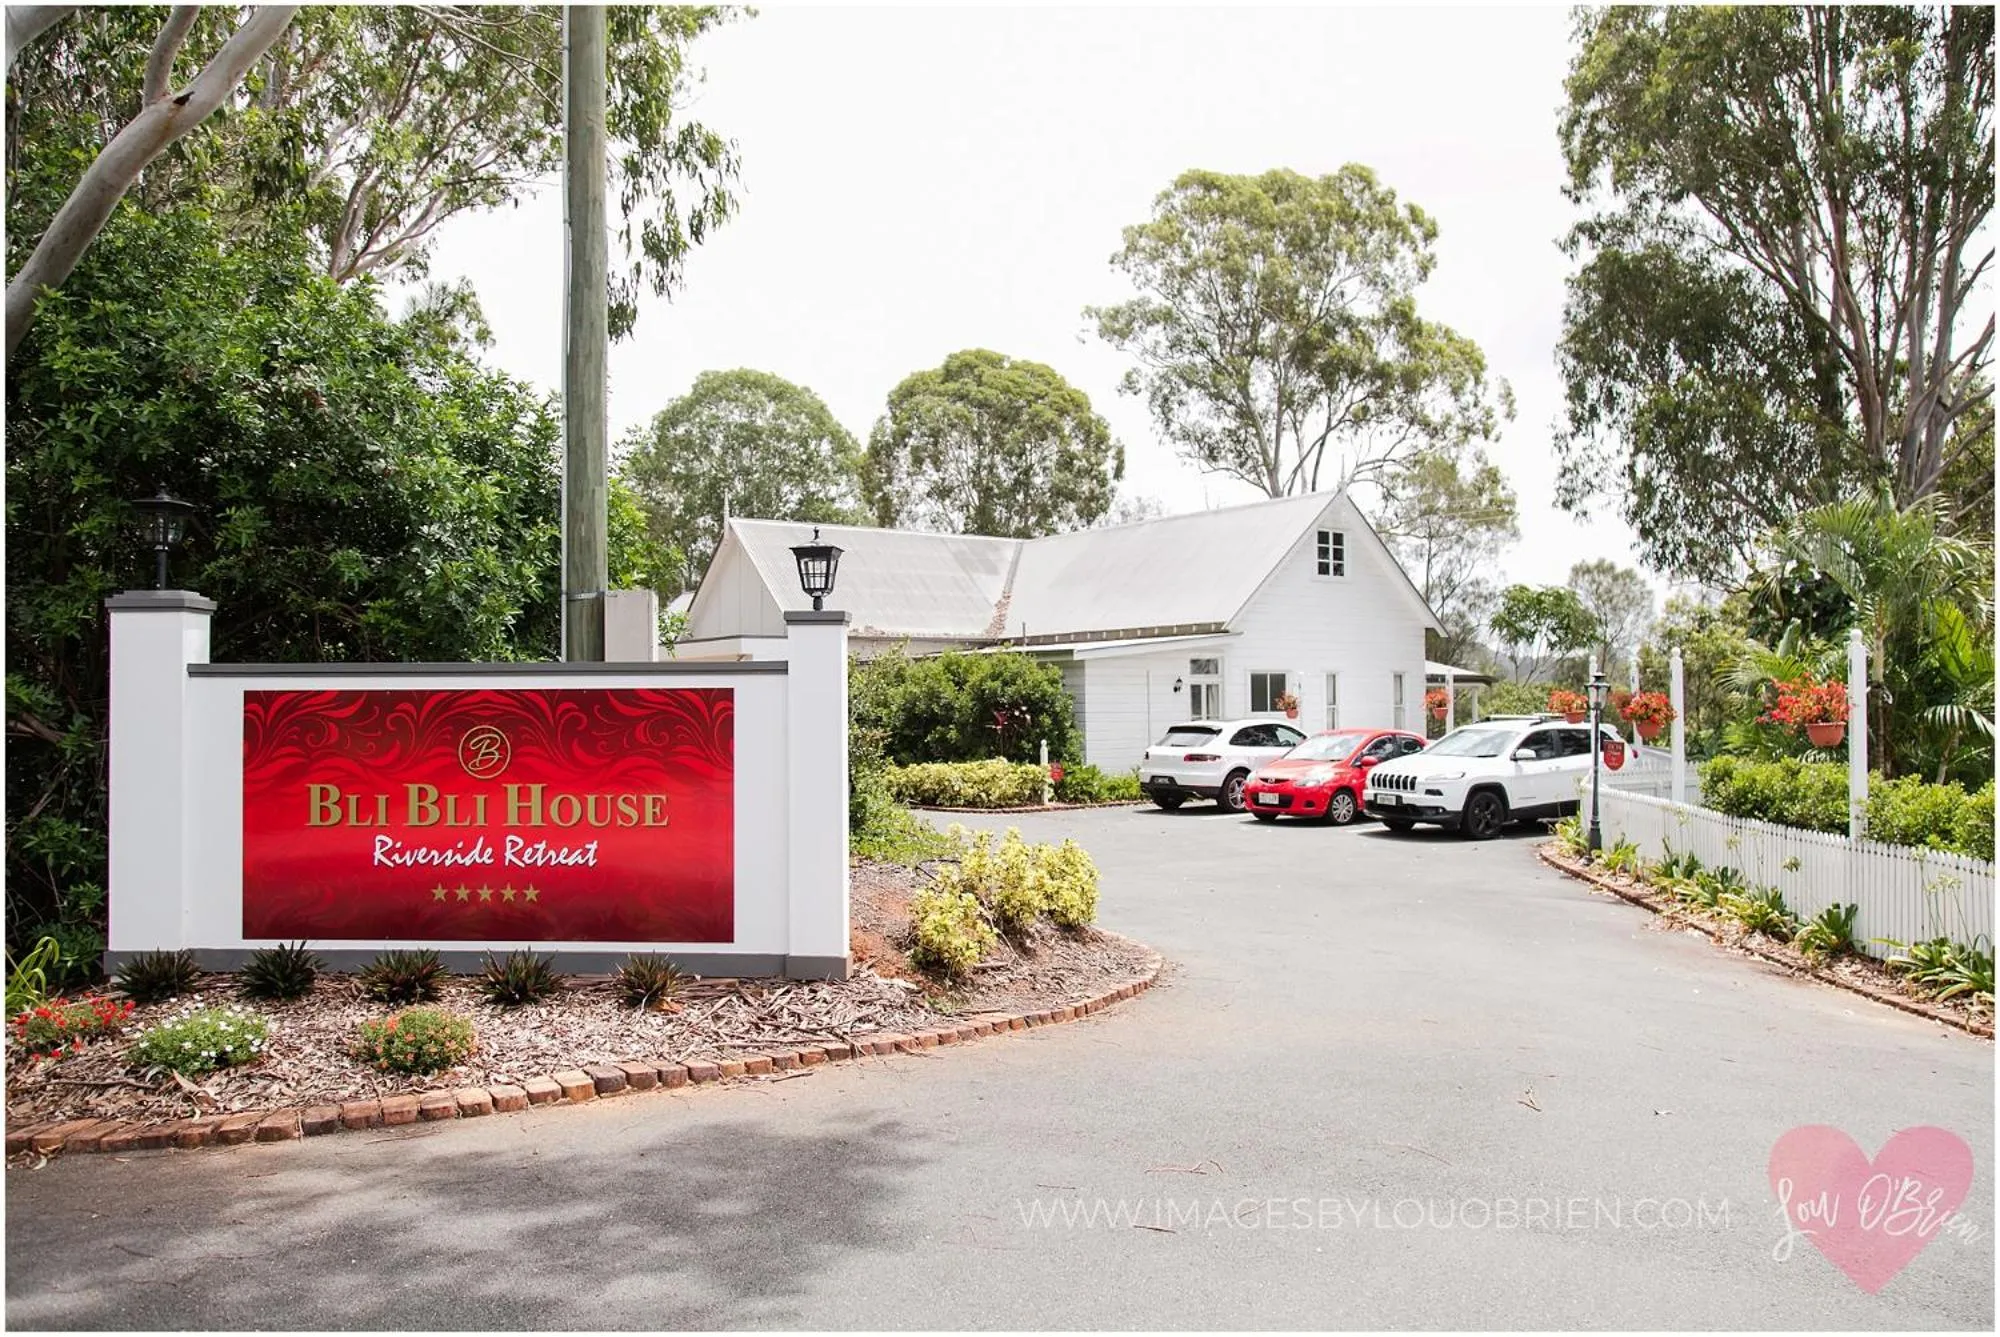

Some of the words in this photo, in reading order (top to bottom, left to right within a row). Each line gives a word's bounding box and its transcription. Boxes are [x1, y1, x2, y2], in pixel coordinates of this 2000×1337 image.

[468, 733, 503, 771] B
[305, 783, 389, 827] BLI
[403, 783, 489, 827] BLI
[502, 783, 669, 827] HOUSE
[373, 834, 494, 868] Riverside
[503, 834, 600, 868] Retreat
